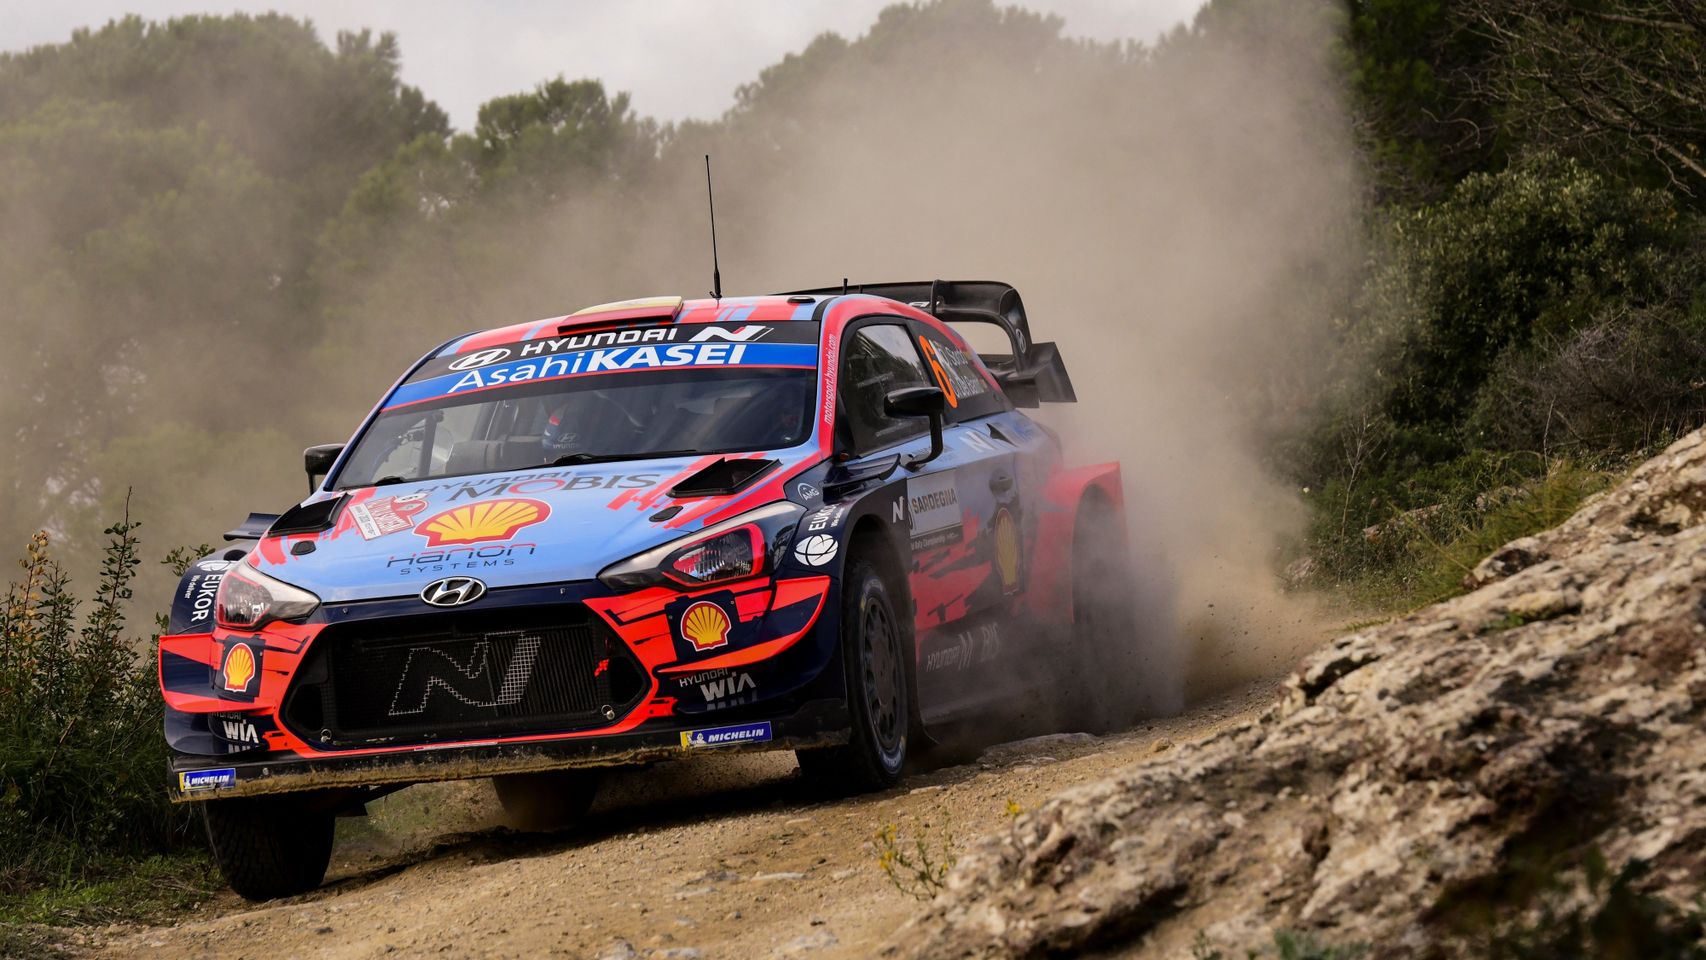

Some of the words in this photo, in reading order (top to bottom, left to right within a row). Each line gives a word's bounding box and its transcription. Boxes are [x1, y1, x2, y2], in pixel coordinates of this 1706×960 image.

[521, 328, 677, 356] HYUNDAI
[824, 333, 836, 425] motorsport.hyundai.com
[919, 335, 958, 408] 6
[415, 471, 571, 494] HYUNDAI
[447, 473, 661, 501] MOBIS
[911, 488, 957, 514] SARDEGNA
[400, 559, 515, 575] SYSTEMS
[191, 574, 223, 622] EUKOR
[680, 668, 728, 688] HYUNDAI
[708, 729, 764, 743] MICHELIN
[191, 775, 230, 785] MICHELIN
